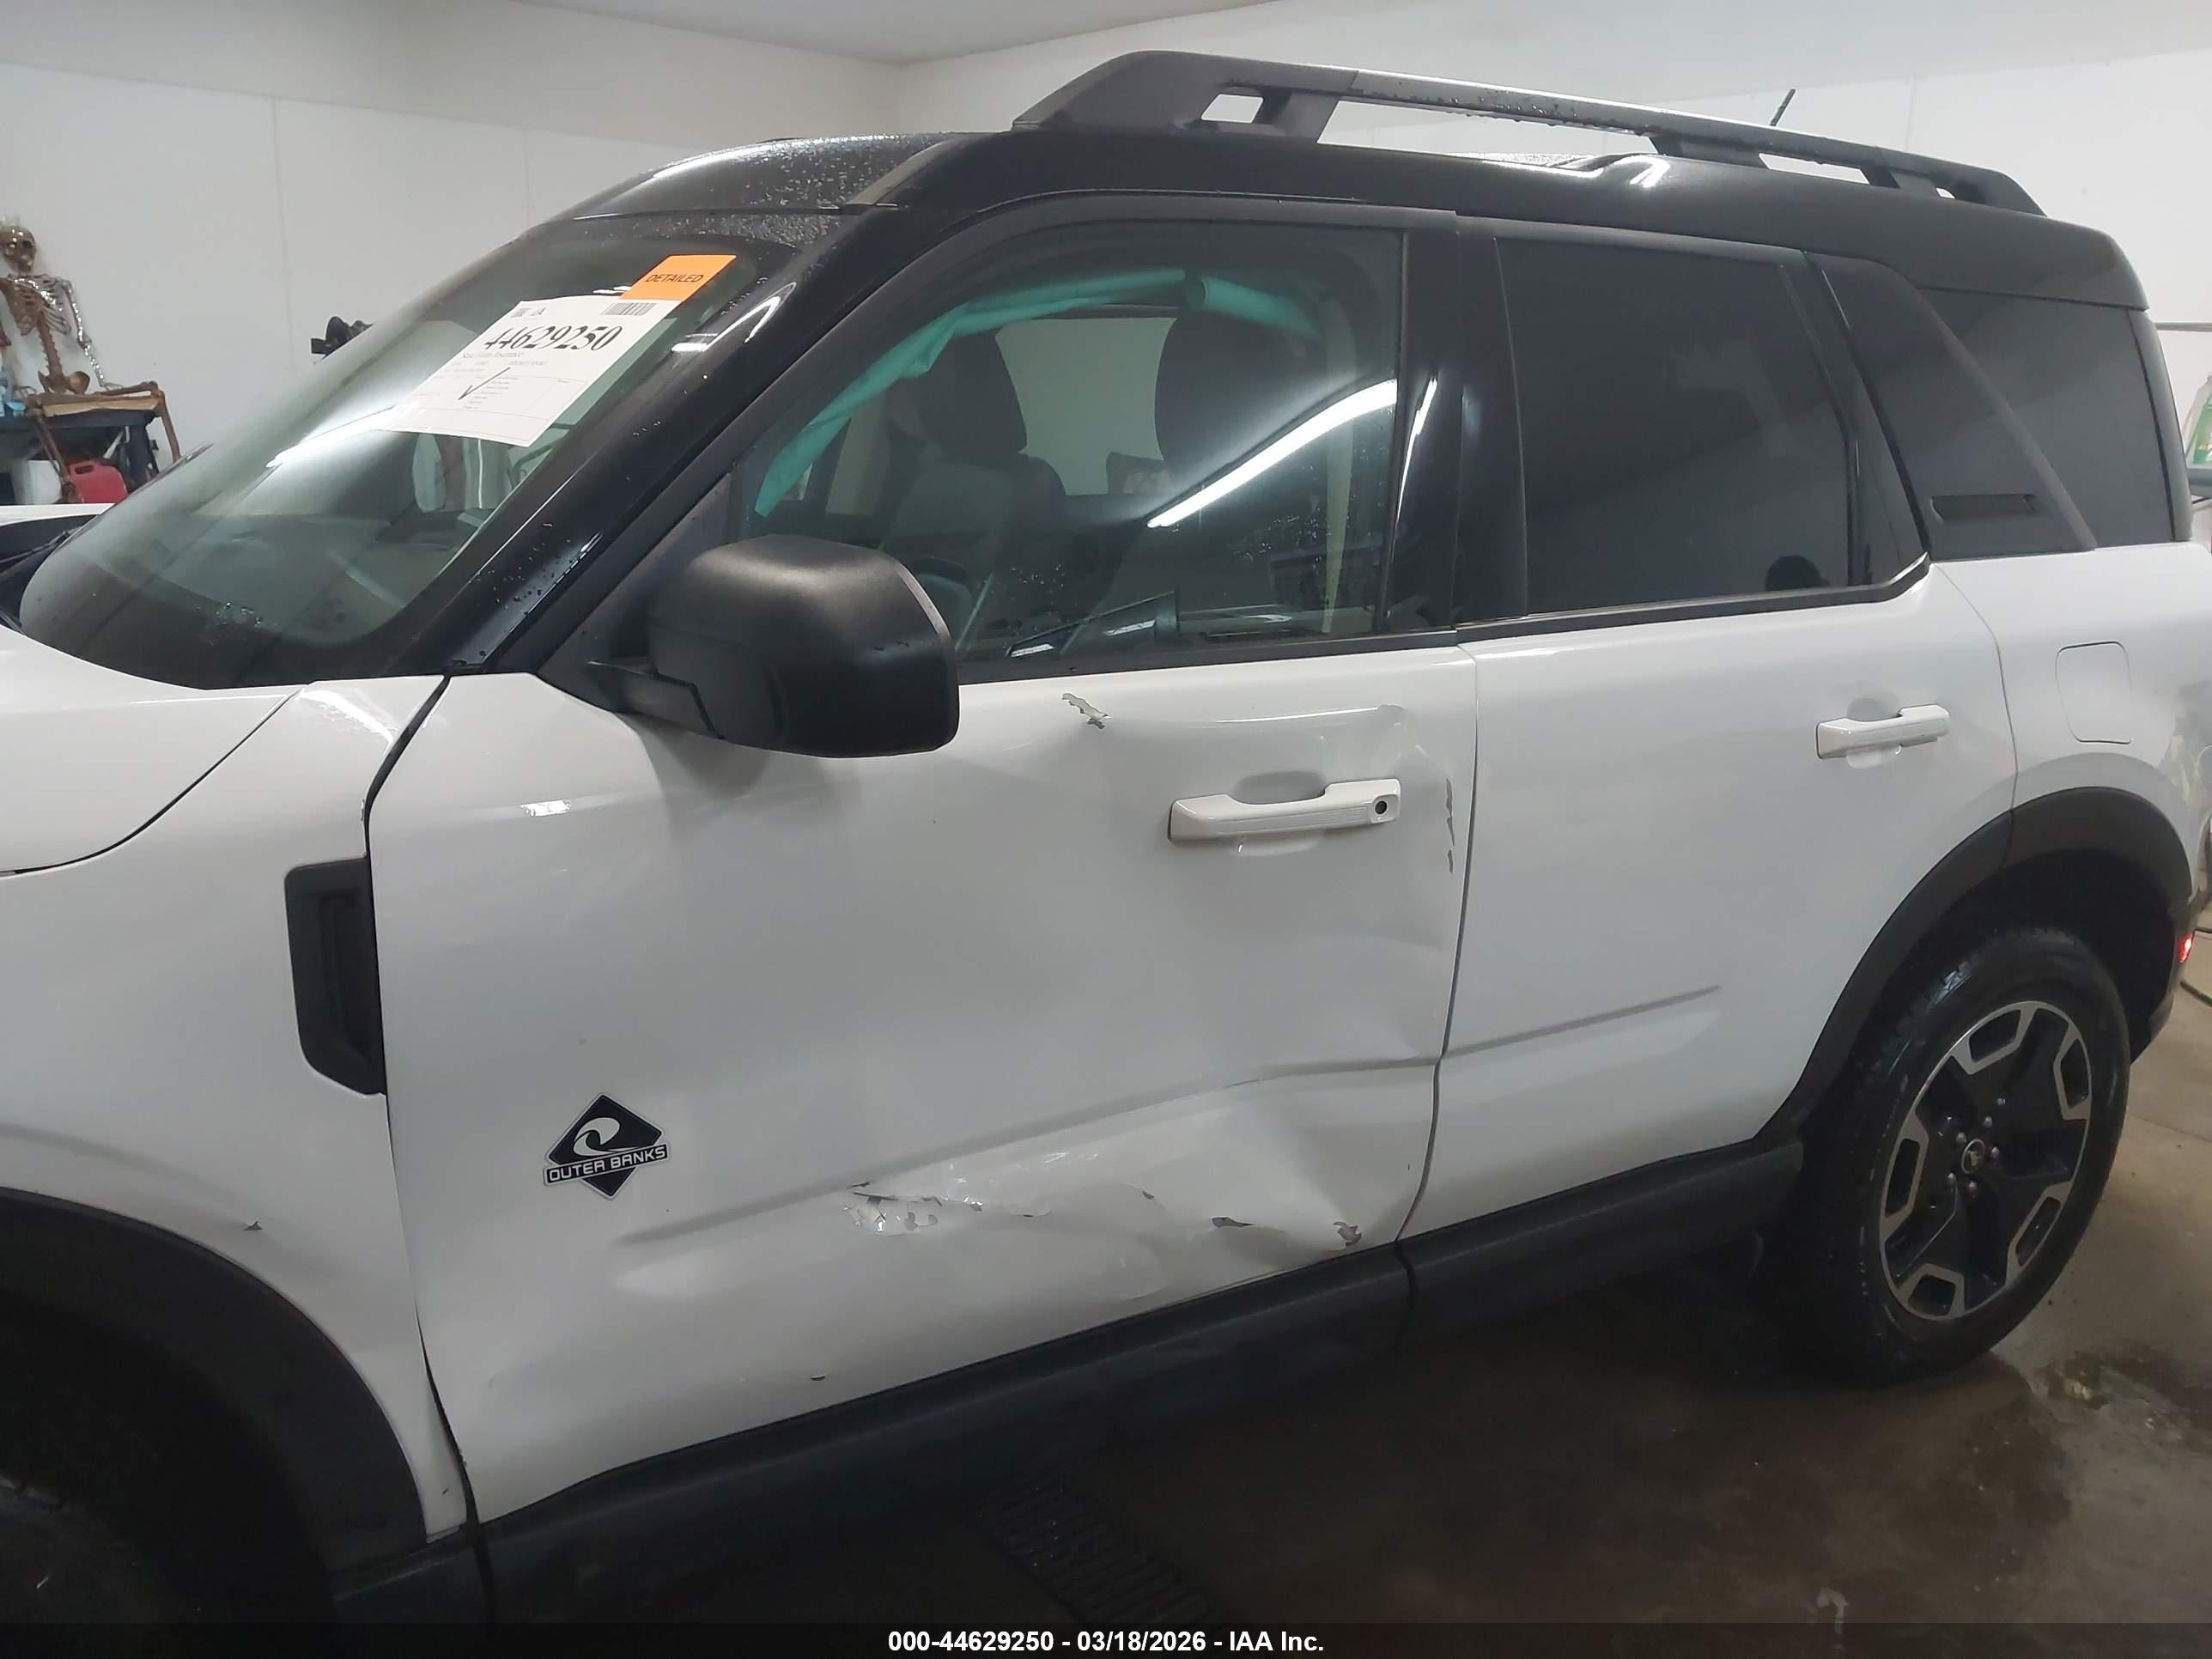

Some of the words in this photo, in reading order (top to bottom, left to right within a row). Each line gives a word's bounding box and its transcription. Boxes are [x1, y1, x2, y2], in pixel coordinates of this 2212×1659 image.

[644, 273, 705, 283] DETAILED
[483, 325, 623, 351] 44629250
[549, 1159, 605, 1182] OUTER
[611, 1146, 665, 1169] BANKS
